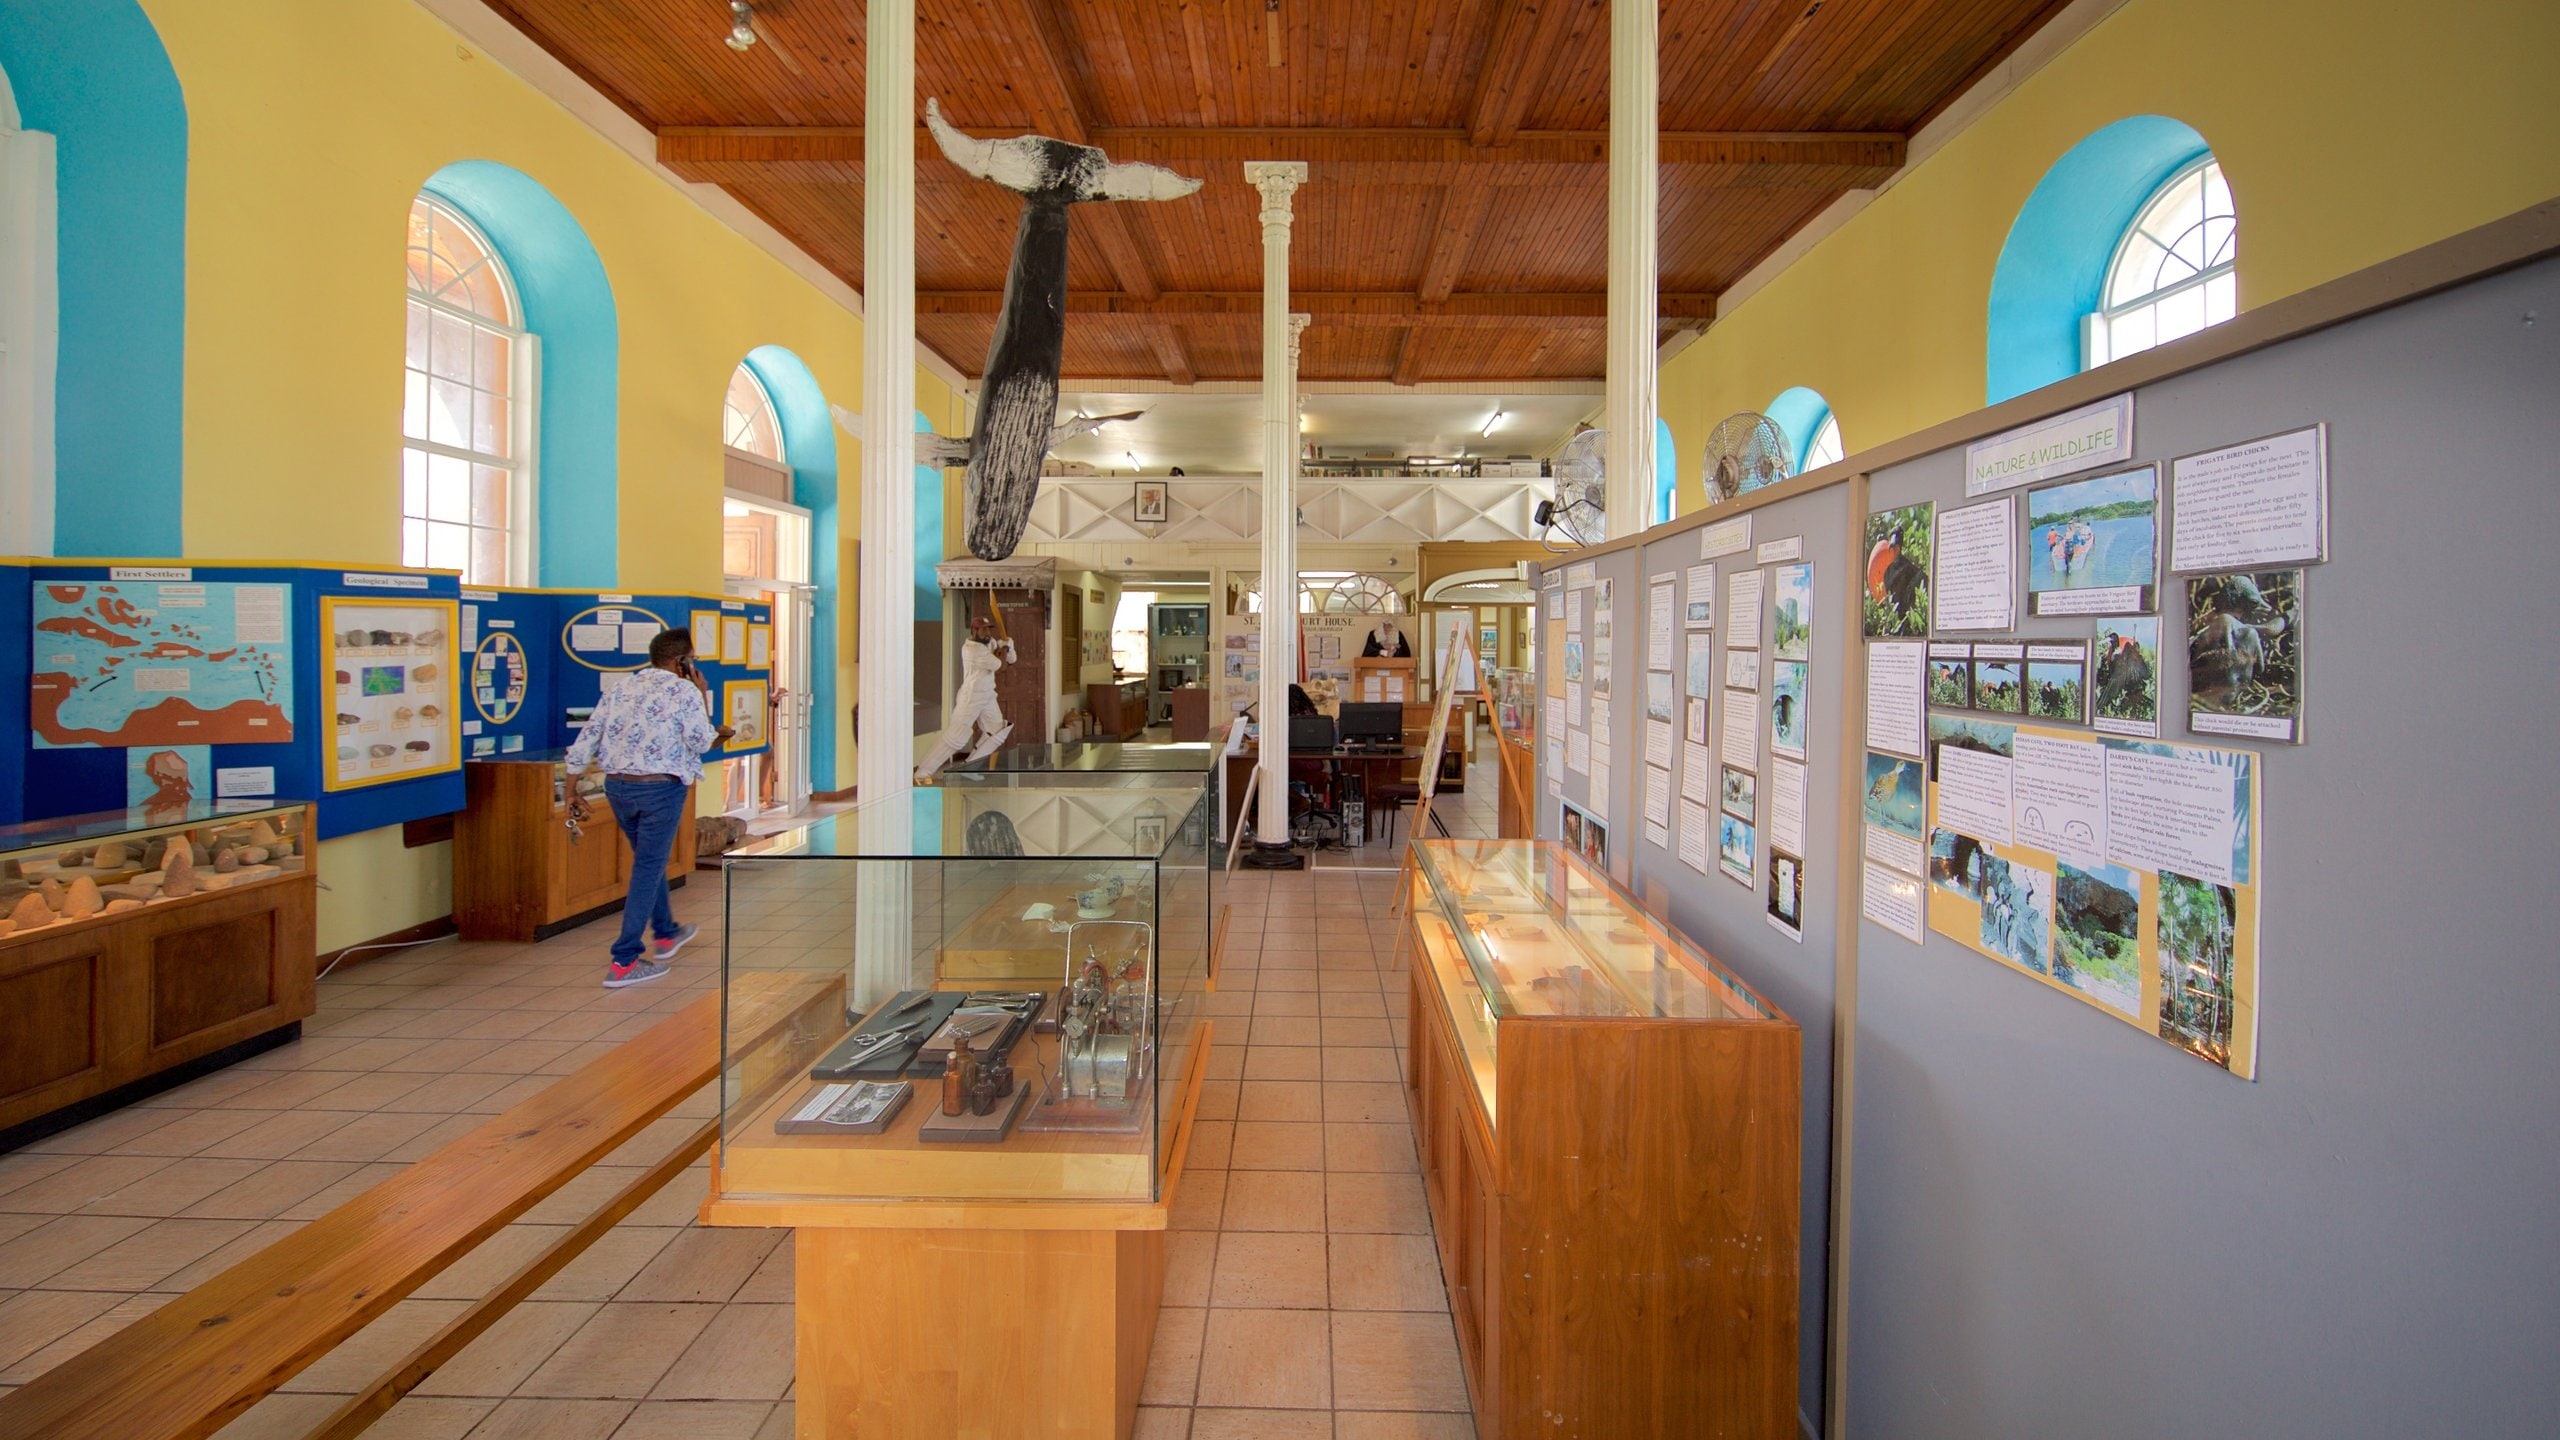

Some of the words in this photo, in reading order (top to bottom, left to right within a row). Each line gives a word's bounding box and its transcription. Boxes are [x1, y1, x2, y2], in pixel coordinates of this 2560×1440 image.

[1976, 454, 2025, 481] NATURE
[2028, 451, 2036, 466] &
[2040, 428, 2113, 463] WILDLIFE
[2196, 455, 2224, 467] FRIGATE
[2227, 451, 2242, 460] BIRD
[2244, 445, 2270, 456] CHICKS
[346, 576, 388, 584] Geological
[1302, 617, 1320, 625] URT
